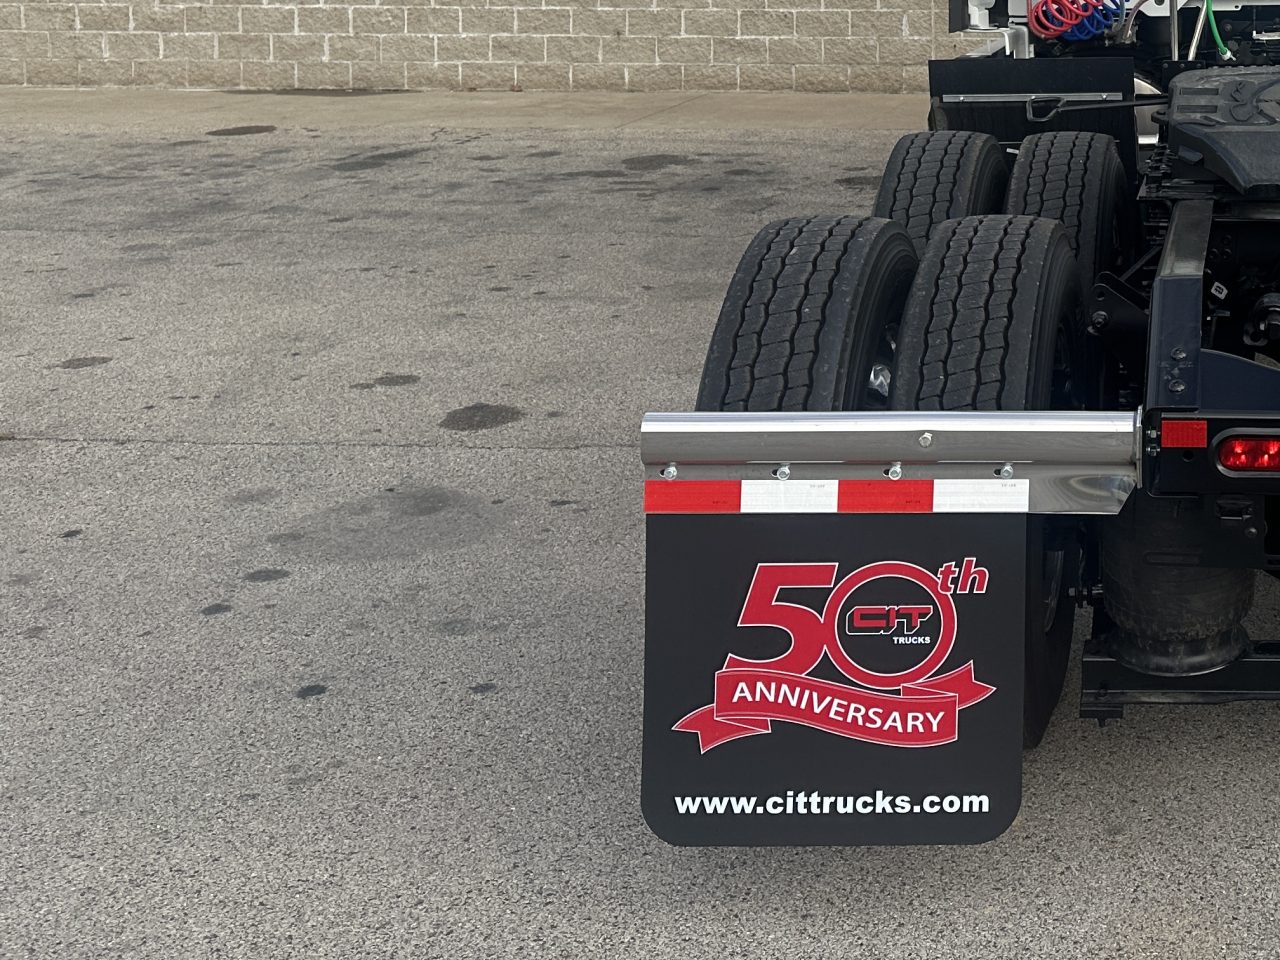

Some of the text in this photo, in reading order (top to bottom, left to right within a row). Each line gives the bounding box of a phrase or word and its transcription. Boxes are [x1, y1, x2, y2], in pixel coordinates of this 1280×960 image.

[846, 605, 933, 635] CIT
[731, 680, 945, 733] ANNIVERSARY
[675, 791, 989, 814] www.cittrucks.com
